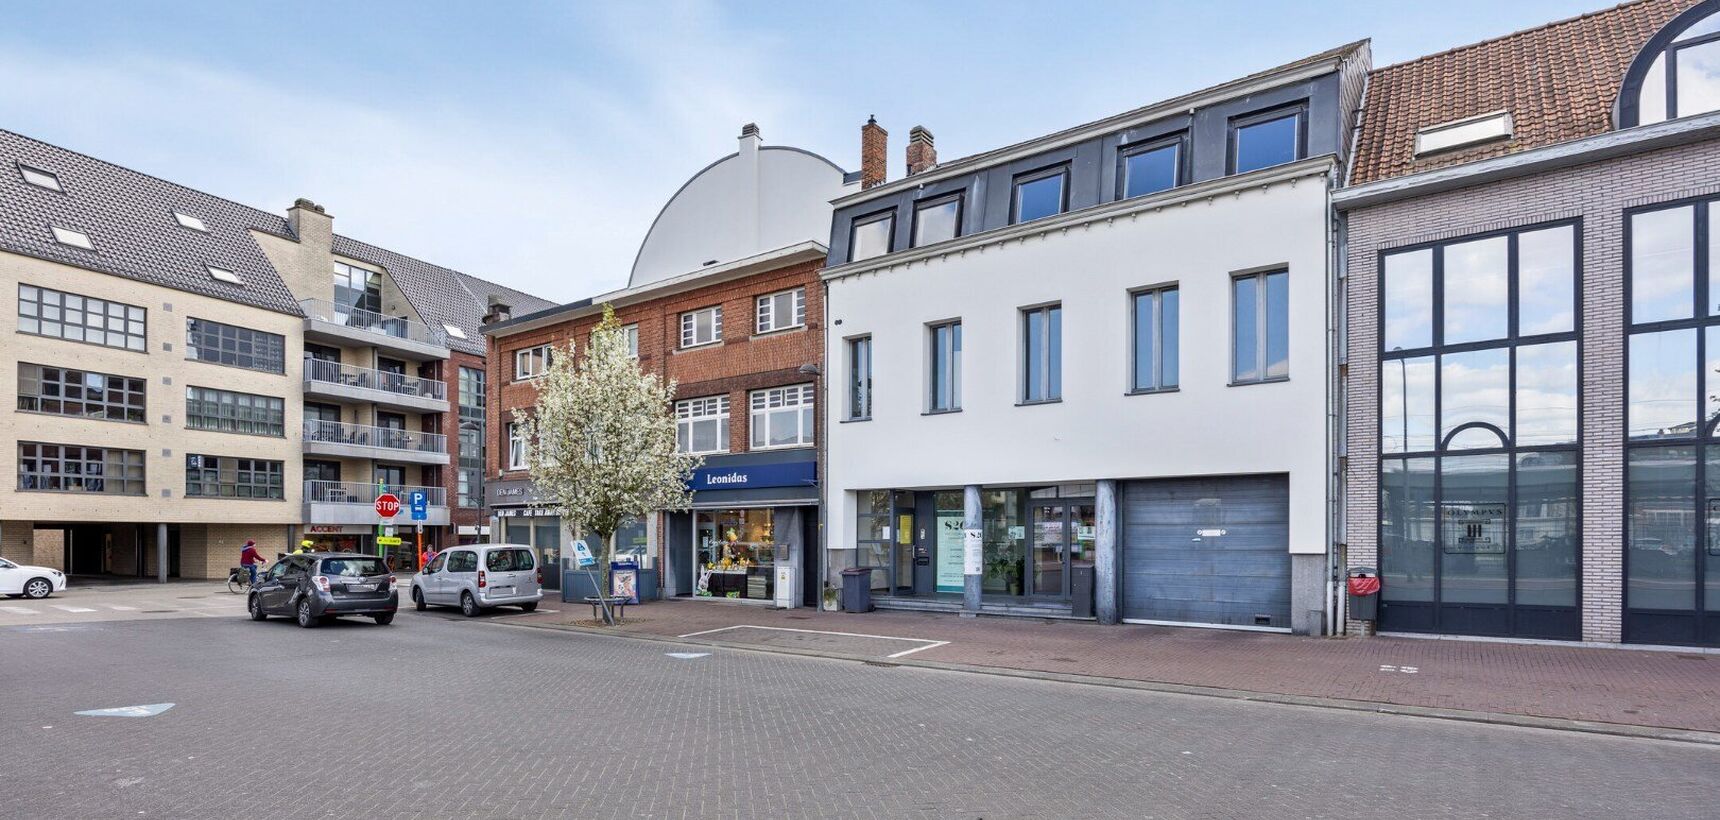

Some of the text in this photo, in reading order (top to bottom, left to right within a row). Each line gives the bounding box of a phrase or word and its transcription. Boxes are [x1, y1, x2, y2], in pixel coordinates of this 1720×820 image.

[707, 472, 748, 484] Leonidas
[507, 487, 523, 495] JAMES
[414, 493, 423, 504] P
[376, 501, 399, 511] STOP
[310, 525, 344, 533] ACCENT
